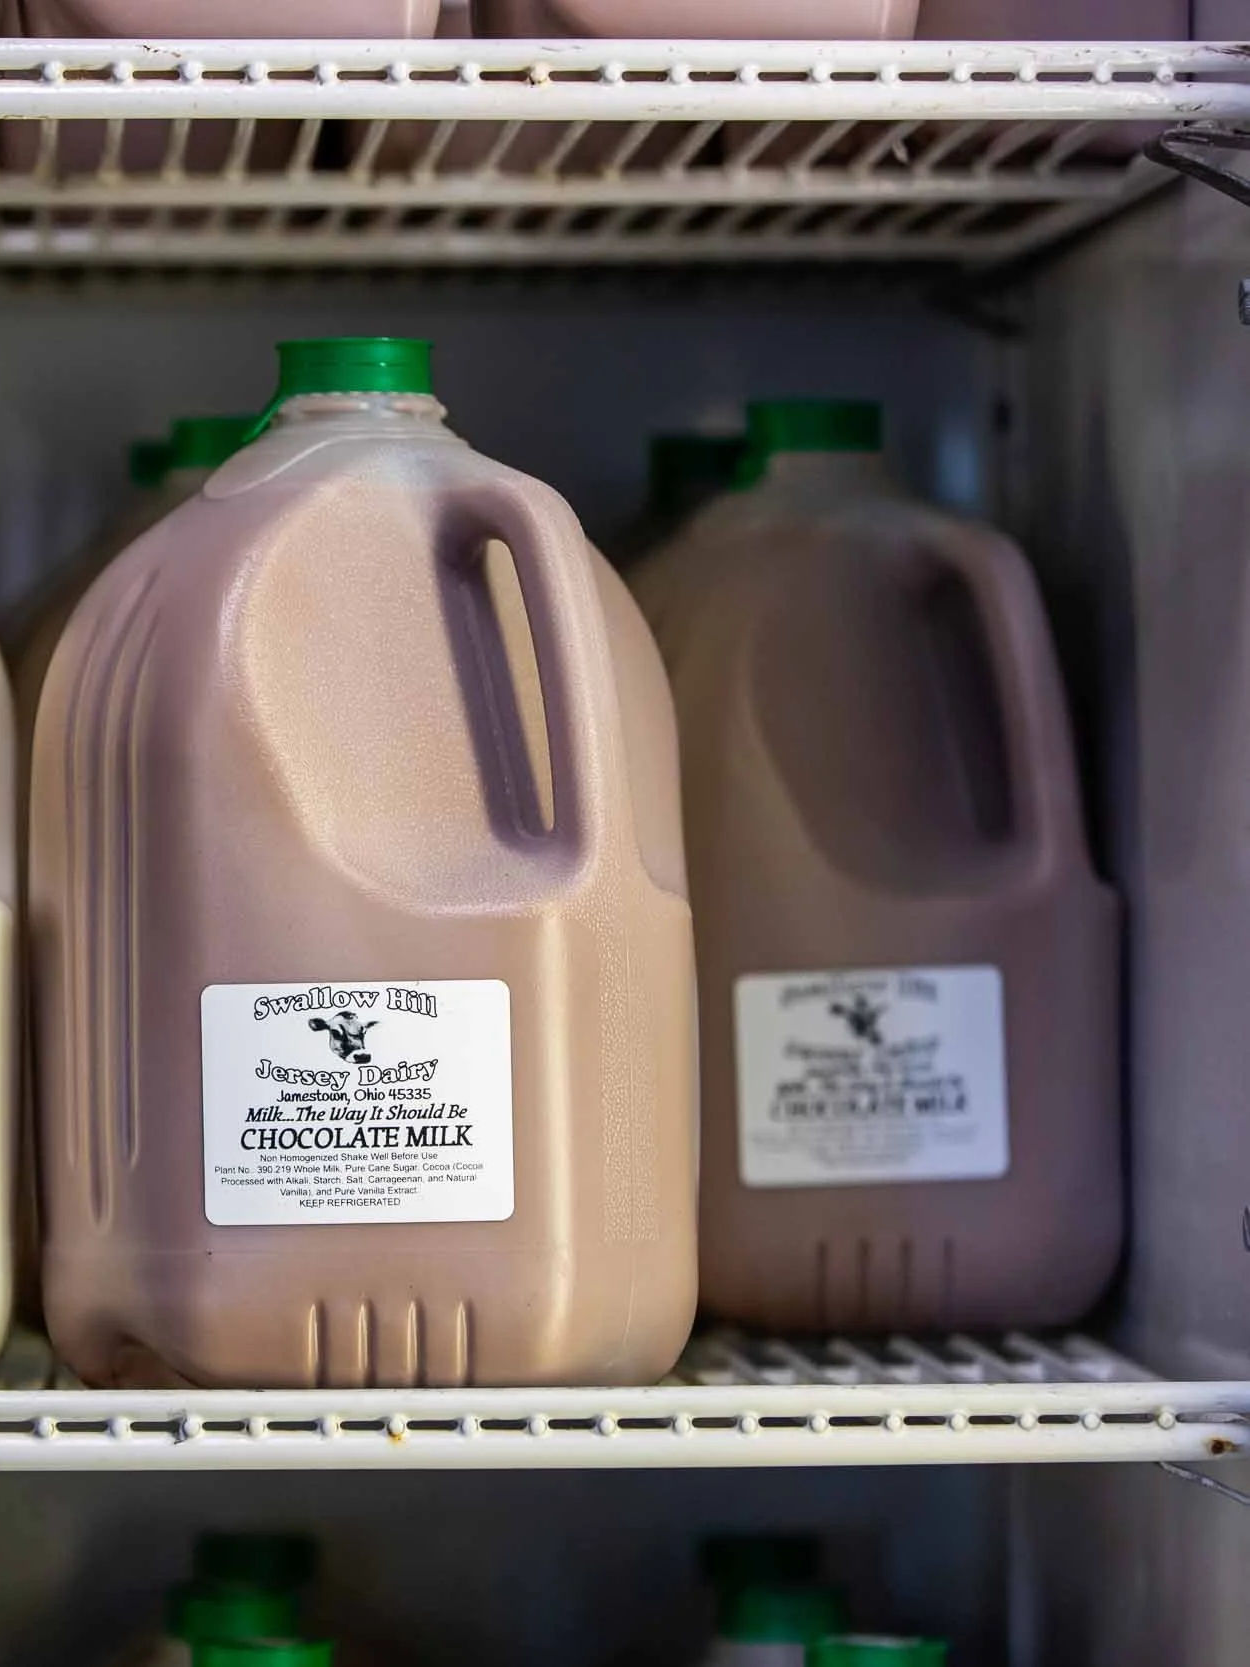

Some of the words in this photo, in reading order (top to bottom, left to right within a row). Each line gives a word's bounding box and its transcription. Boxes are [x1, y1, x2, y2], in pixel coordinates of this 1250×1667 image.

[253, 986, 379, 1021] Swallow
[387, 988, 438, 1018] Hill
[255, 1059, 350, 1091] Jersey
[358, 1059, 438, 1086] Dairy
[276, 1089, 351, 1104] Jamestown,
[354, 1089, 385, 1102] Ohio
[388, 1088, 432, 1101] 45335
[329, 1107, 368, 1124] Way
[369, 1106, 384, 1121] It
[386, 1104, 444, 1120] Should
[446, 1104, 468, 1120] Be
[240, 1126, 400, 1151] CHOCOLATE
[404, 1124, 473, 1149] MILK
[260, 1154, 277, 1163] Non
[279, 1153, 339, 1164] Homogenized
[341, 1152, 368, 1161] Shake
[370, 1152, 389, 1161] Well
[391, 1152, 419, 1160] Before
[421, 1151, 438, 1160] Use
[214, 1166, 236, 1175] Plant
[293, 1164, 321, 1173] Whole
[345, 1163, 366, 1173] Pure
[367, 1163, 390, 1172] Cane
[422, 1162, 451, 1171] Cocoa
[221, 1177, 265, 1186] Processed
[266, 1176, 284, 1185] with
[427, 1174, 444, 1183] and
[446, 1174, 477, 1183] Natural
[315, 1188, 332, 1196] and
[334, 1187, 356, 1196] Pure
[357, 1187, 385, 1195] Vanilla
[299, 1199, 325, 1208] KEEP
[327, 1197, 401, 1207] REFRIGERATED
